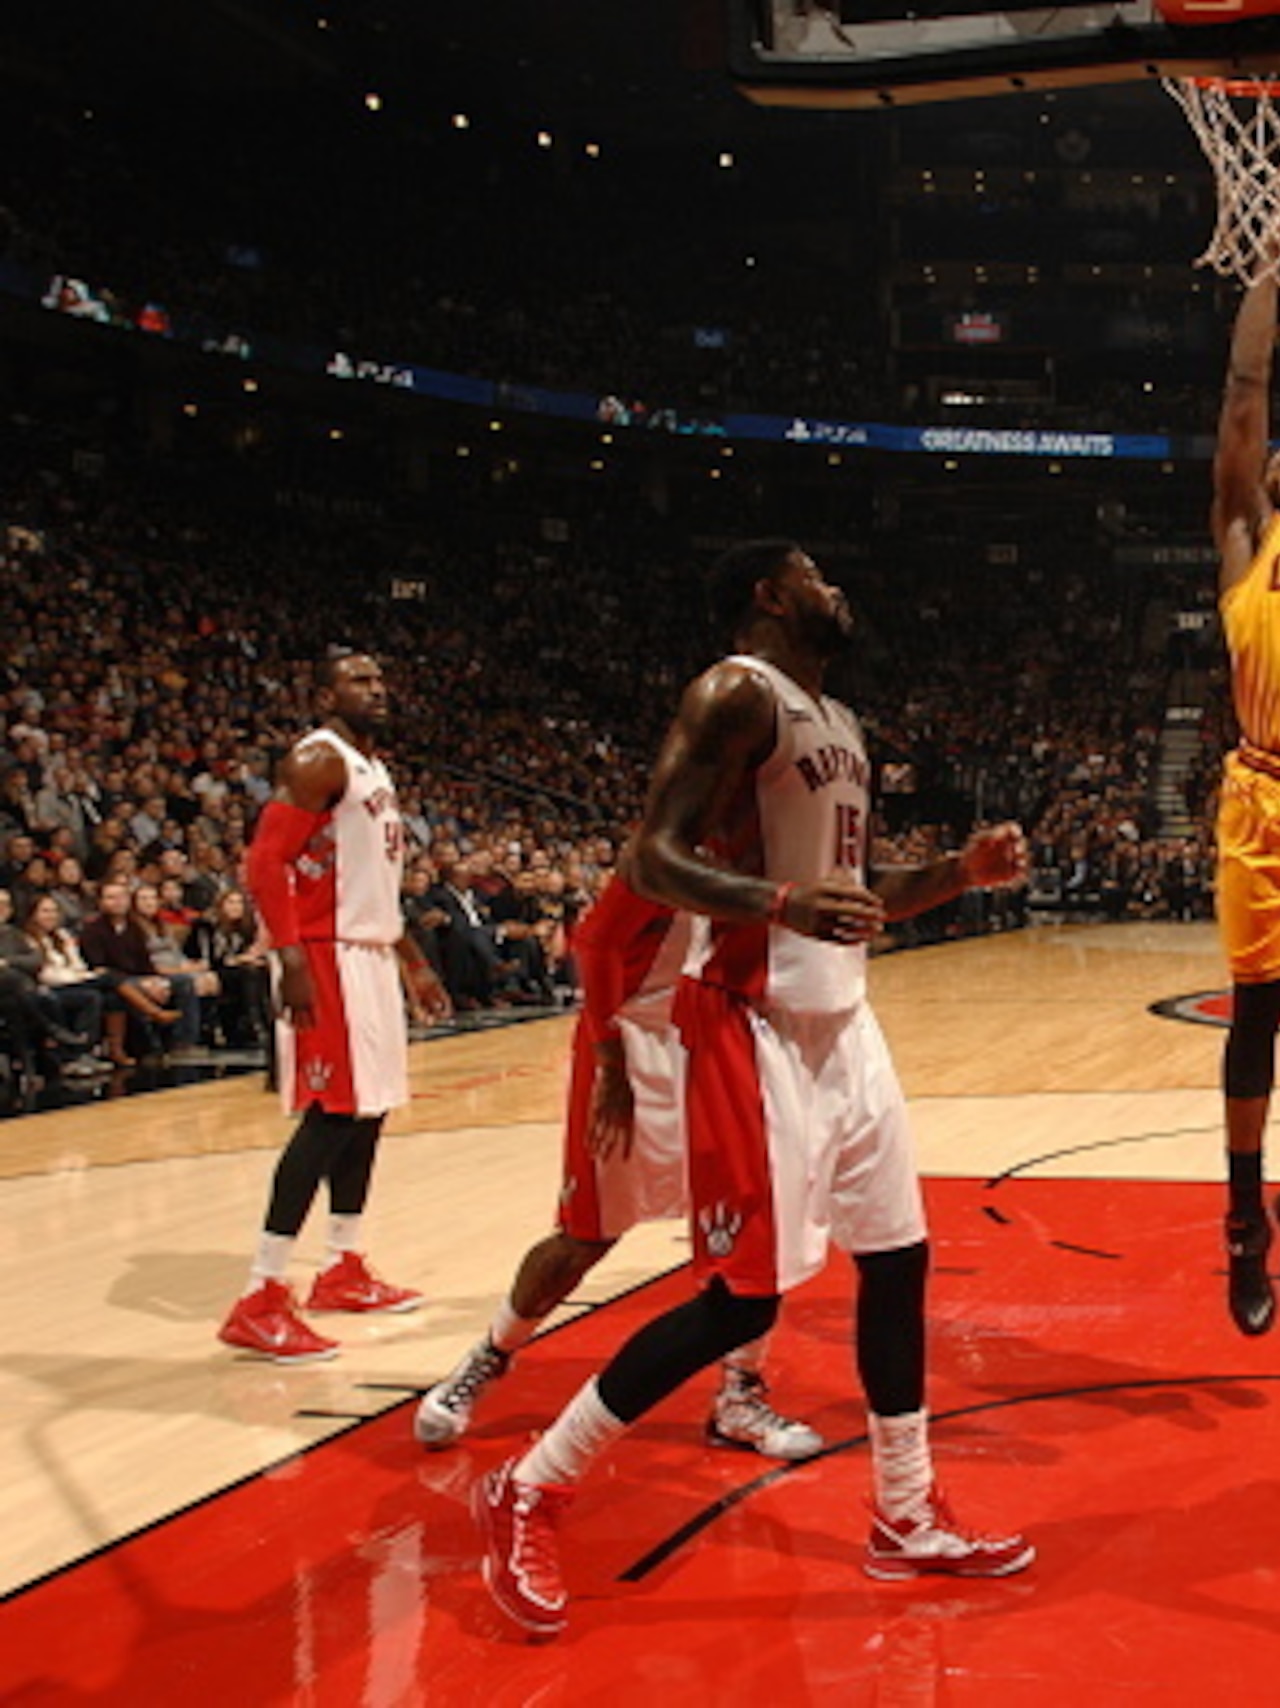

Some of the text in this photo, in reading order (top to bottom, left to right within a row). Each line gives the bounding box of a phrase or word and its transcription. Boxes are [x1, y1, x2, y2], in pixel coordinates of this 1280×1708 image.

[356, 360, 413, 389] PS4
[813, 423, 867, 443] PS4
[919, 430, 1114, 456] GREATNESS AWAITS
